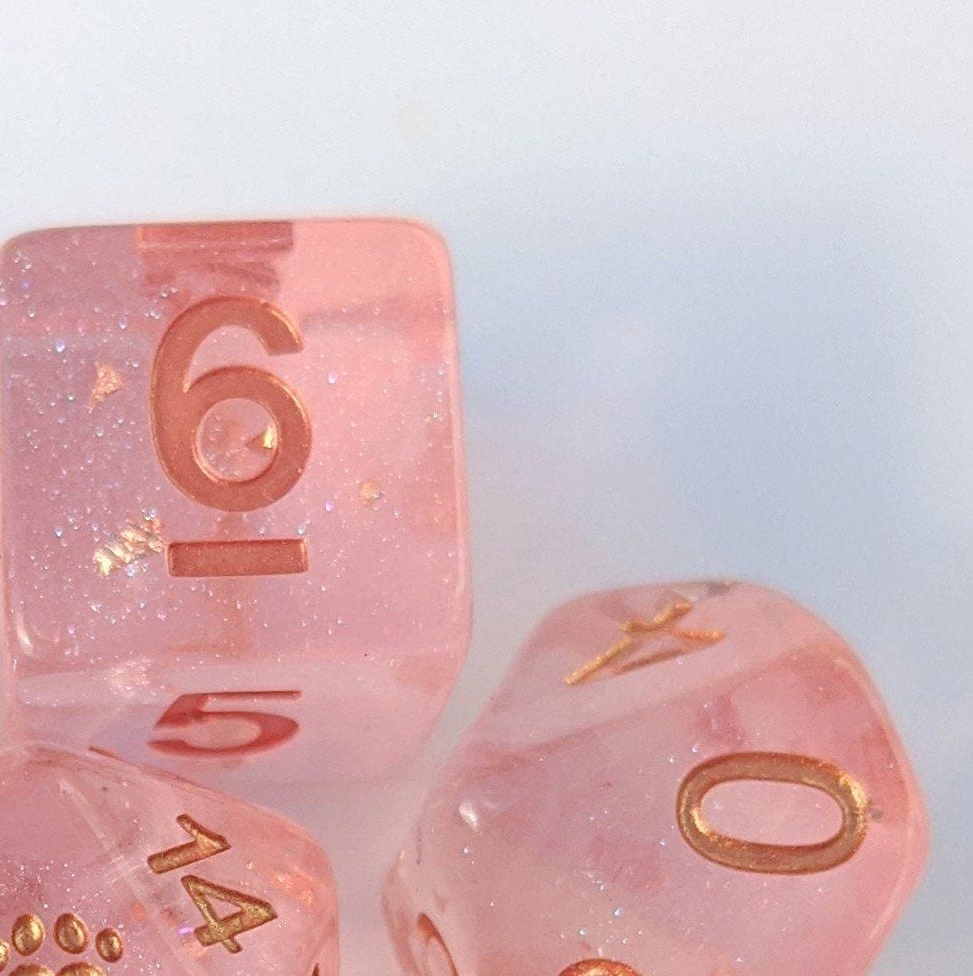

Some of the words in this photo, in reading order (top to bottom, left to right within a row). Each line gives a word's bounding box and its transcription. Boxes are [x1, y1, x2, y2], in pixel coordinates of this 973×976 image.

[149, 295, 312, 513] 6
[147, 690, 302, 757] 5
[676, 751, 869, 876] 0
[147, 814, 279, 954] 14
